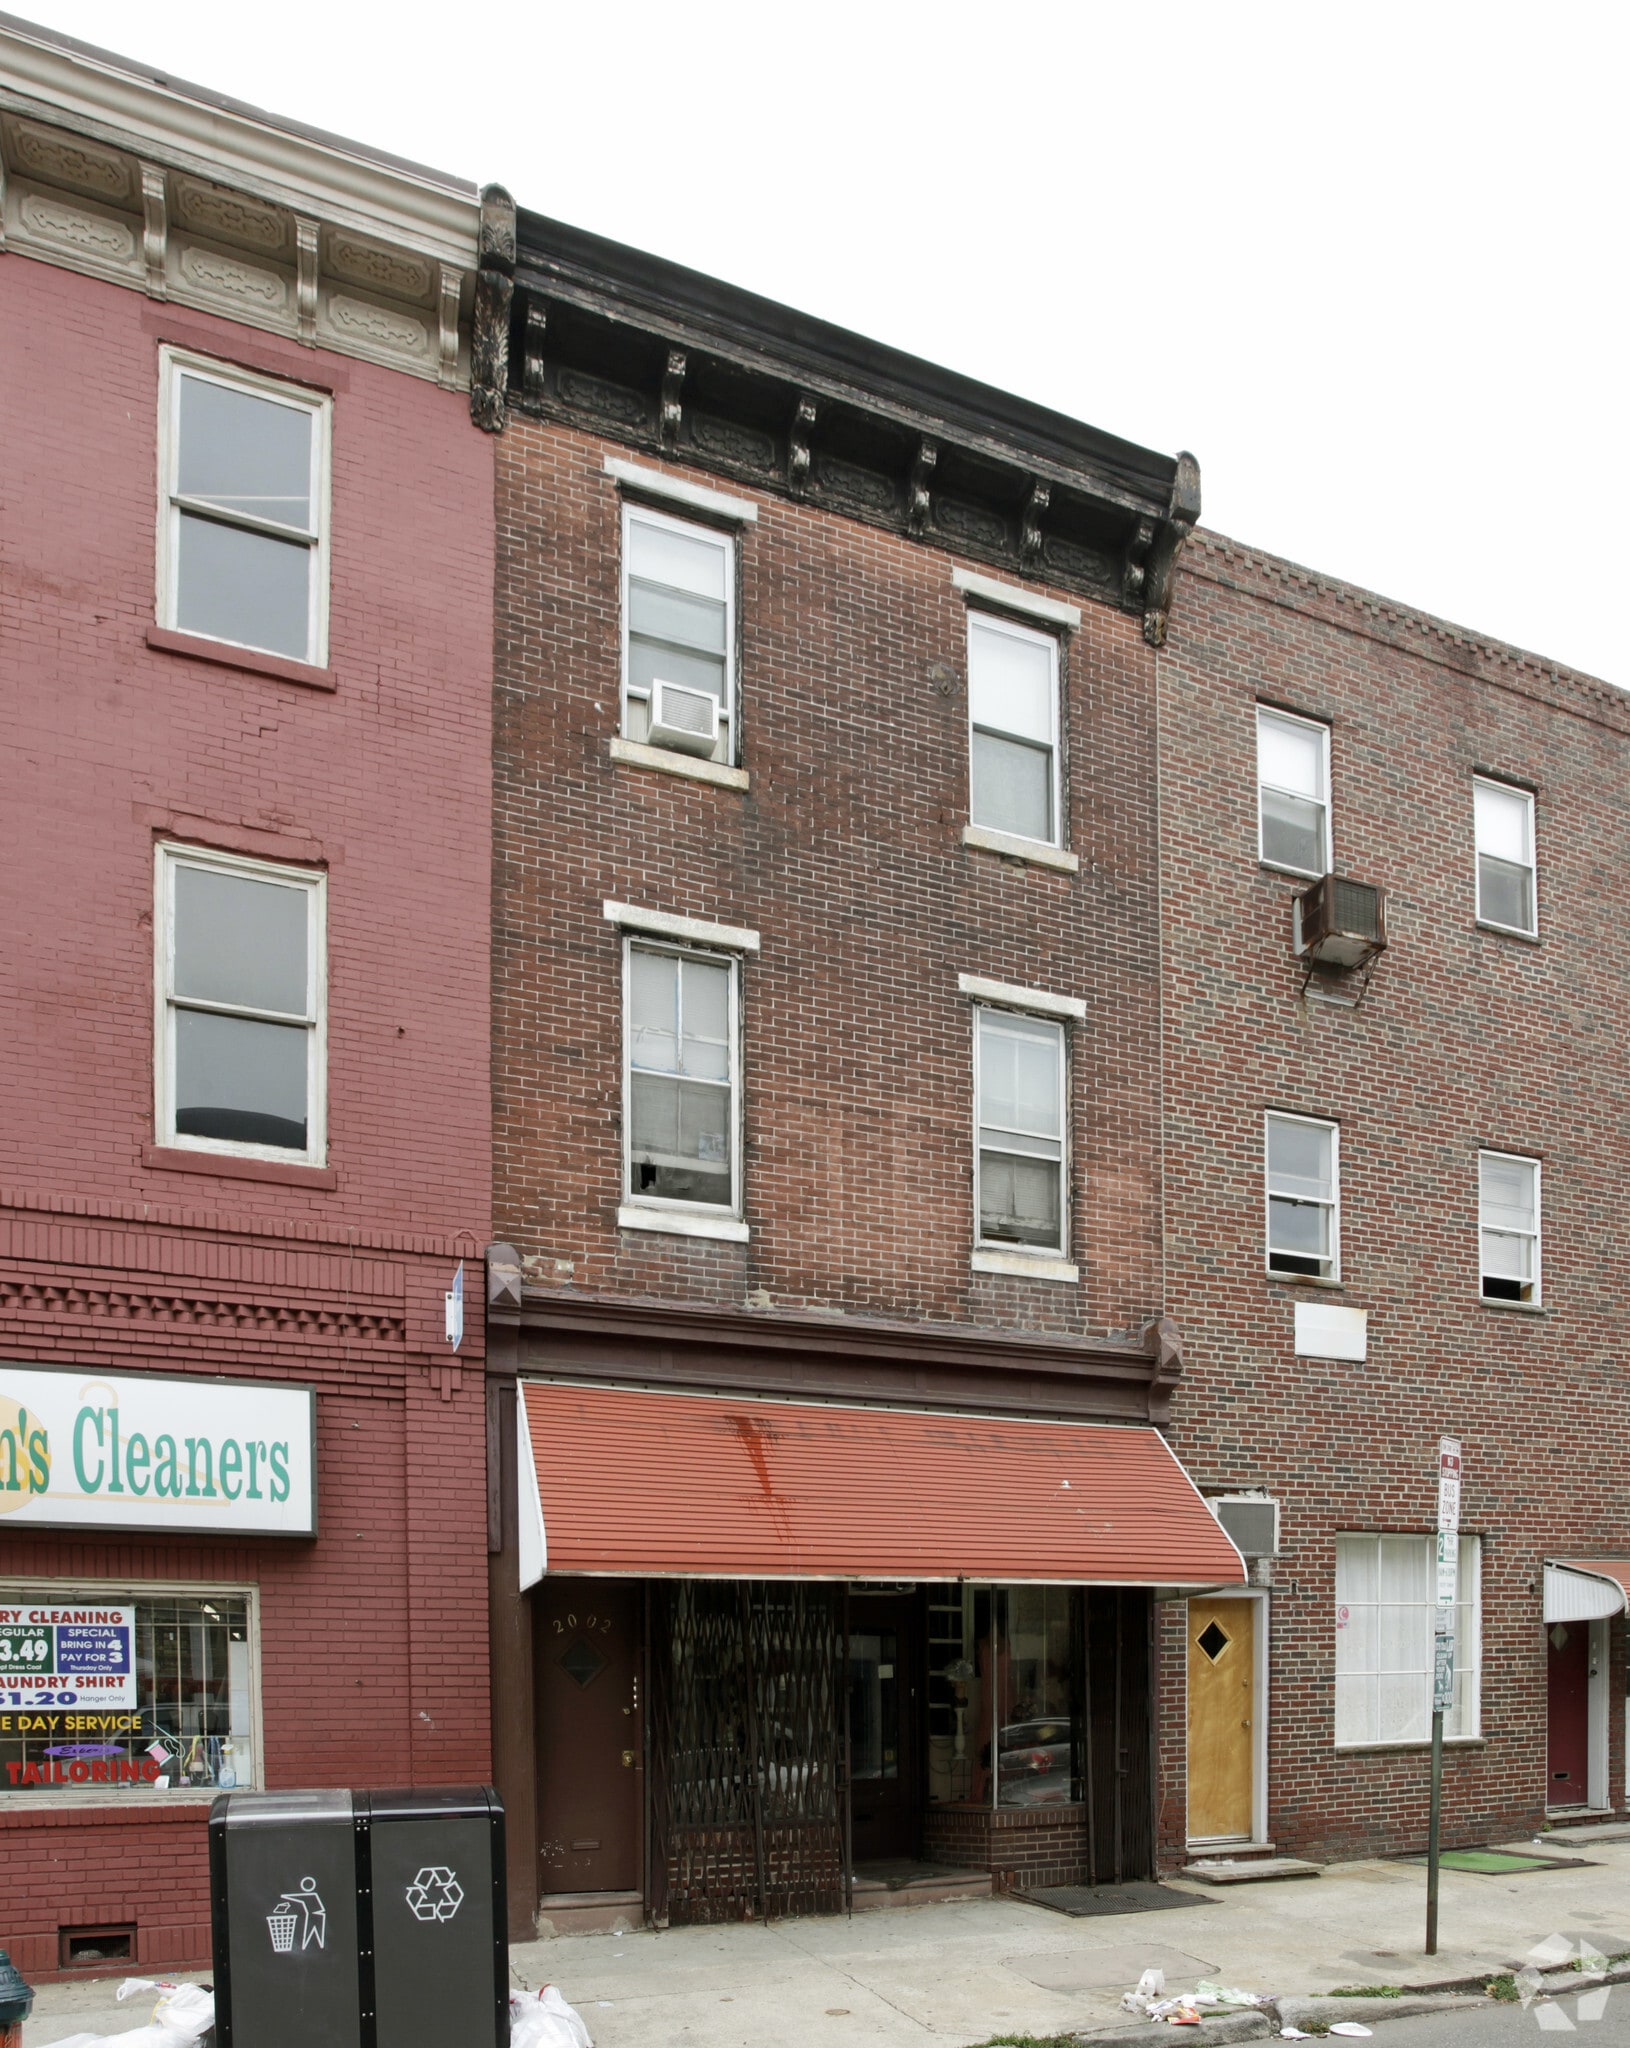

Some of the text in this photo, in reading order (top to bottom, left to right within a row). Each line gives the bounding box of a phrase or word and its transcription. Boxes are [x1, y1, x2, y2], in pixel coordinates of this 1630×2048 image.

[73, 1406, 291, 1503] Cleaners
[1444, 1483, 1455, 1498] BUS
[1442, 1500, 1456, 1515] ZONE
[1439, 1537, 1444, 1556] 2
[28, 1611, 123, 1624] CLEANING
[0, 1628, 44, 1637] GULAR
[68, 1628, 117, 1638] SPECIAL
[60, 1639, 123, 1651] BRING IN 4
[60, 1651, 123, 1663] PAY FOR 3
[70, 1664, 113, 1672] Thursday Only
[75, 1676, 126, 1688] SHIRT
[80, 1695, 106, 1703] Hanger
[108, 1695, 126, 1703] Only
[18, 1715, 59, 1730] DAY
[65, 1715, 142, 1730] SERVICE
[6, 1759, 161, 1785] TAILORING
